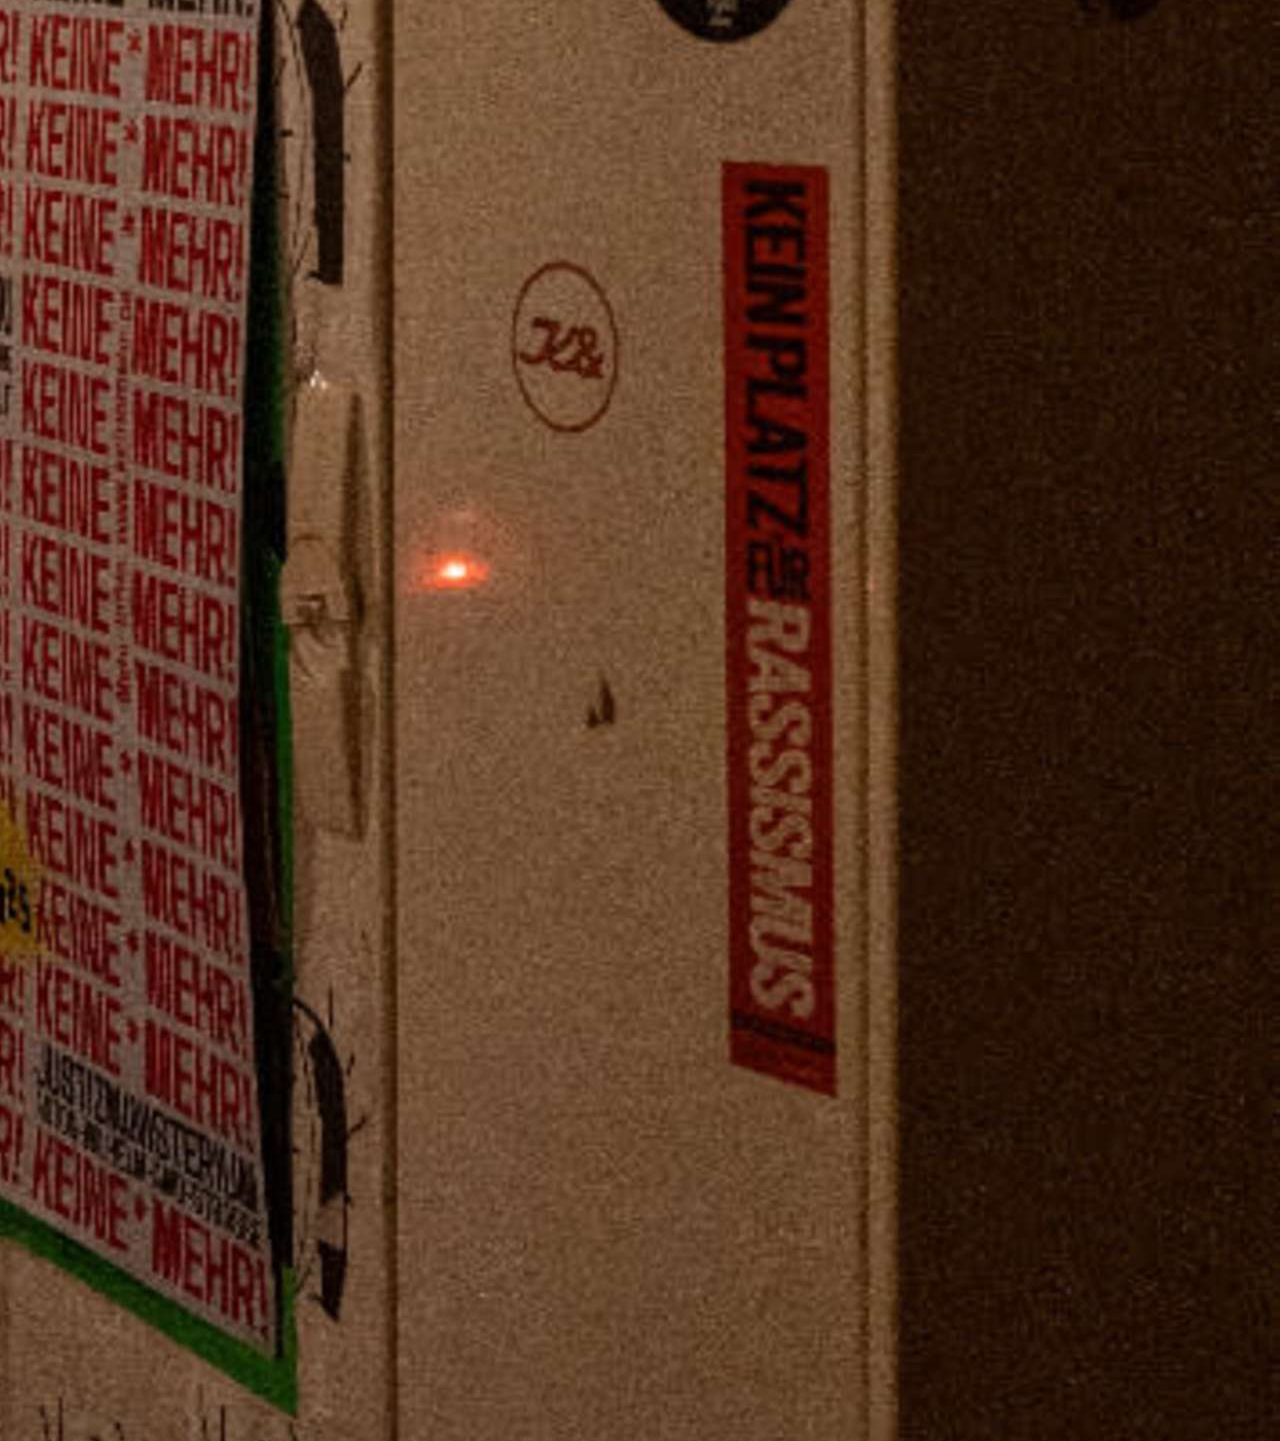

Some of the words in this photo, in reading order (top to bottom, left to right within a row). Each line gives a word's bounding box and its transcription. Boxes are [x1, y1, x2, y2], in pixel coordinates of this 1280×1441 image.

[145, 23, 251, 114] MEHR!
[141, 113, 247, 208] MEHR!
[140, 204, 241, 304] MEHR!
[745, 177, 808, 326] KEIN
[22, 273, 115, 365] KEINE
[132, 296, 239, 398] MEHR!
[22, 358, 109, 455] KEINE
[134, 389, 239, 495] MEHR!
[746, 338, 811, 538] PLATZ
[22, 445, 110, 545] KEINE
[134, 479, 238, 590] MEHR!
[22, 530, 111, 635] KEINE
[133, 569, 238, 683] MEHR!
[22, 616, 114, 723] KEINE
[136, 663, 239, 778] MEHR!
[138, 750, 240, 874] MEHR!
[746, 595, 816, 1019] RASSISMUS
[141, 839, 242, 963] MEHR!
[145, 928, 244, 1053] MEHR!
[144, 1019, 255, 1155] MEHR!
[152, 1198, 269, 1342] MEHR!
